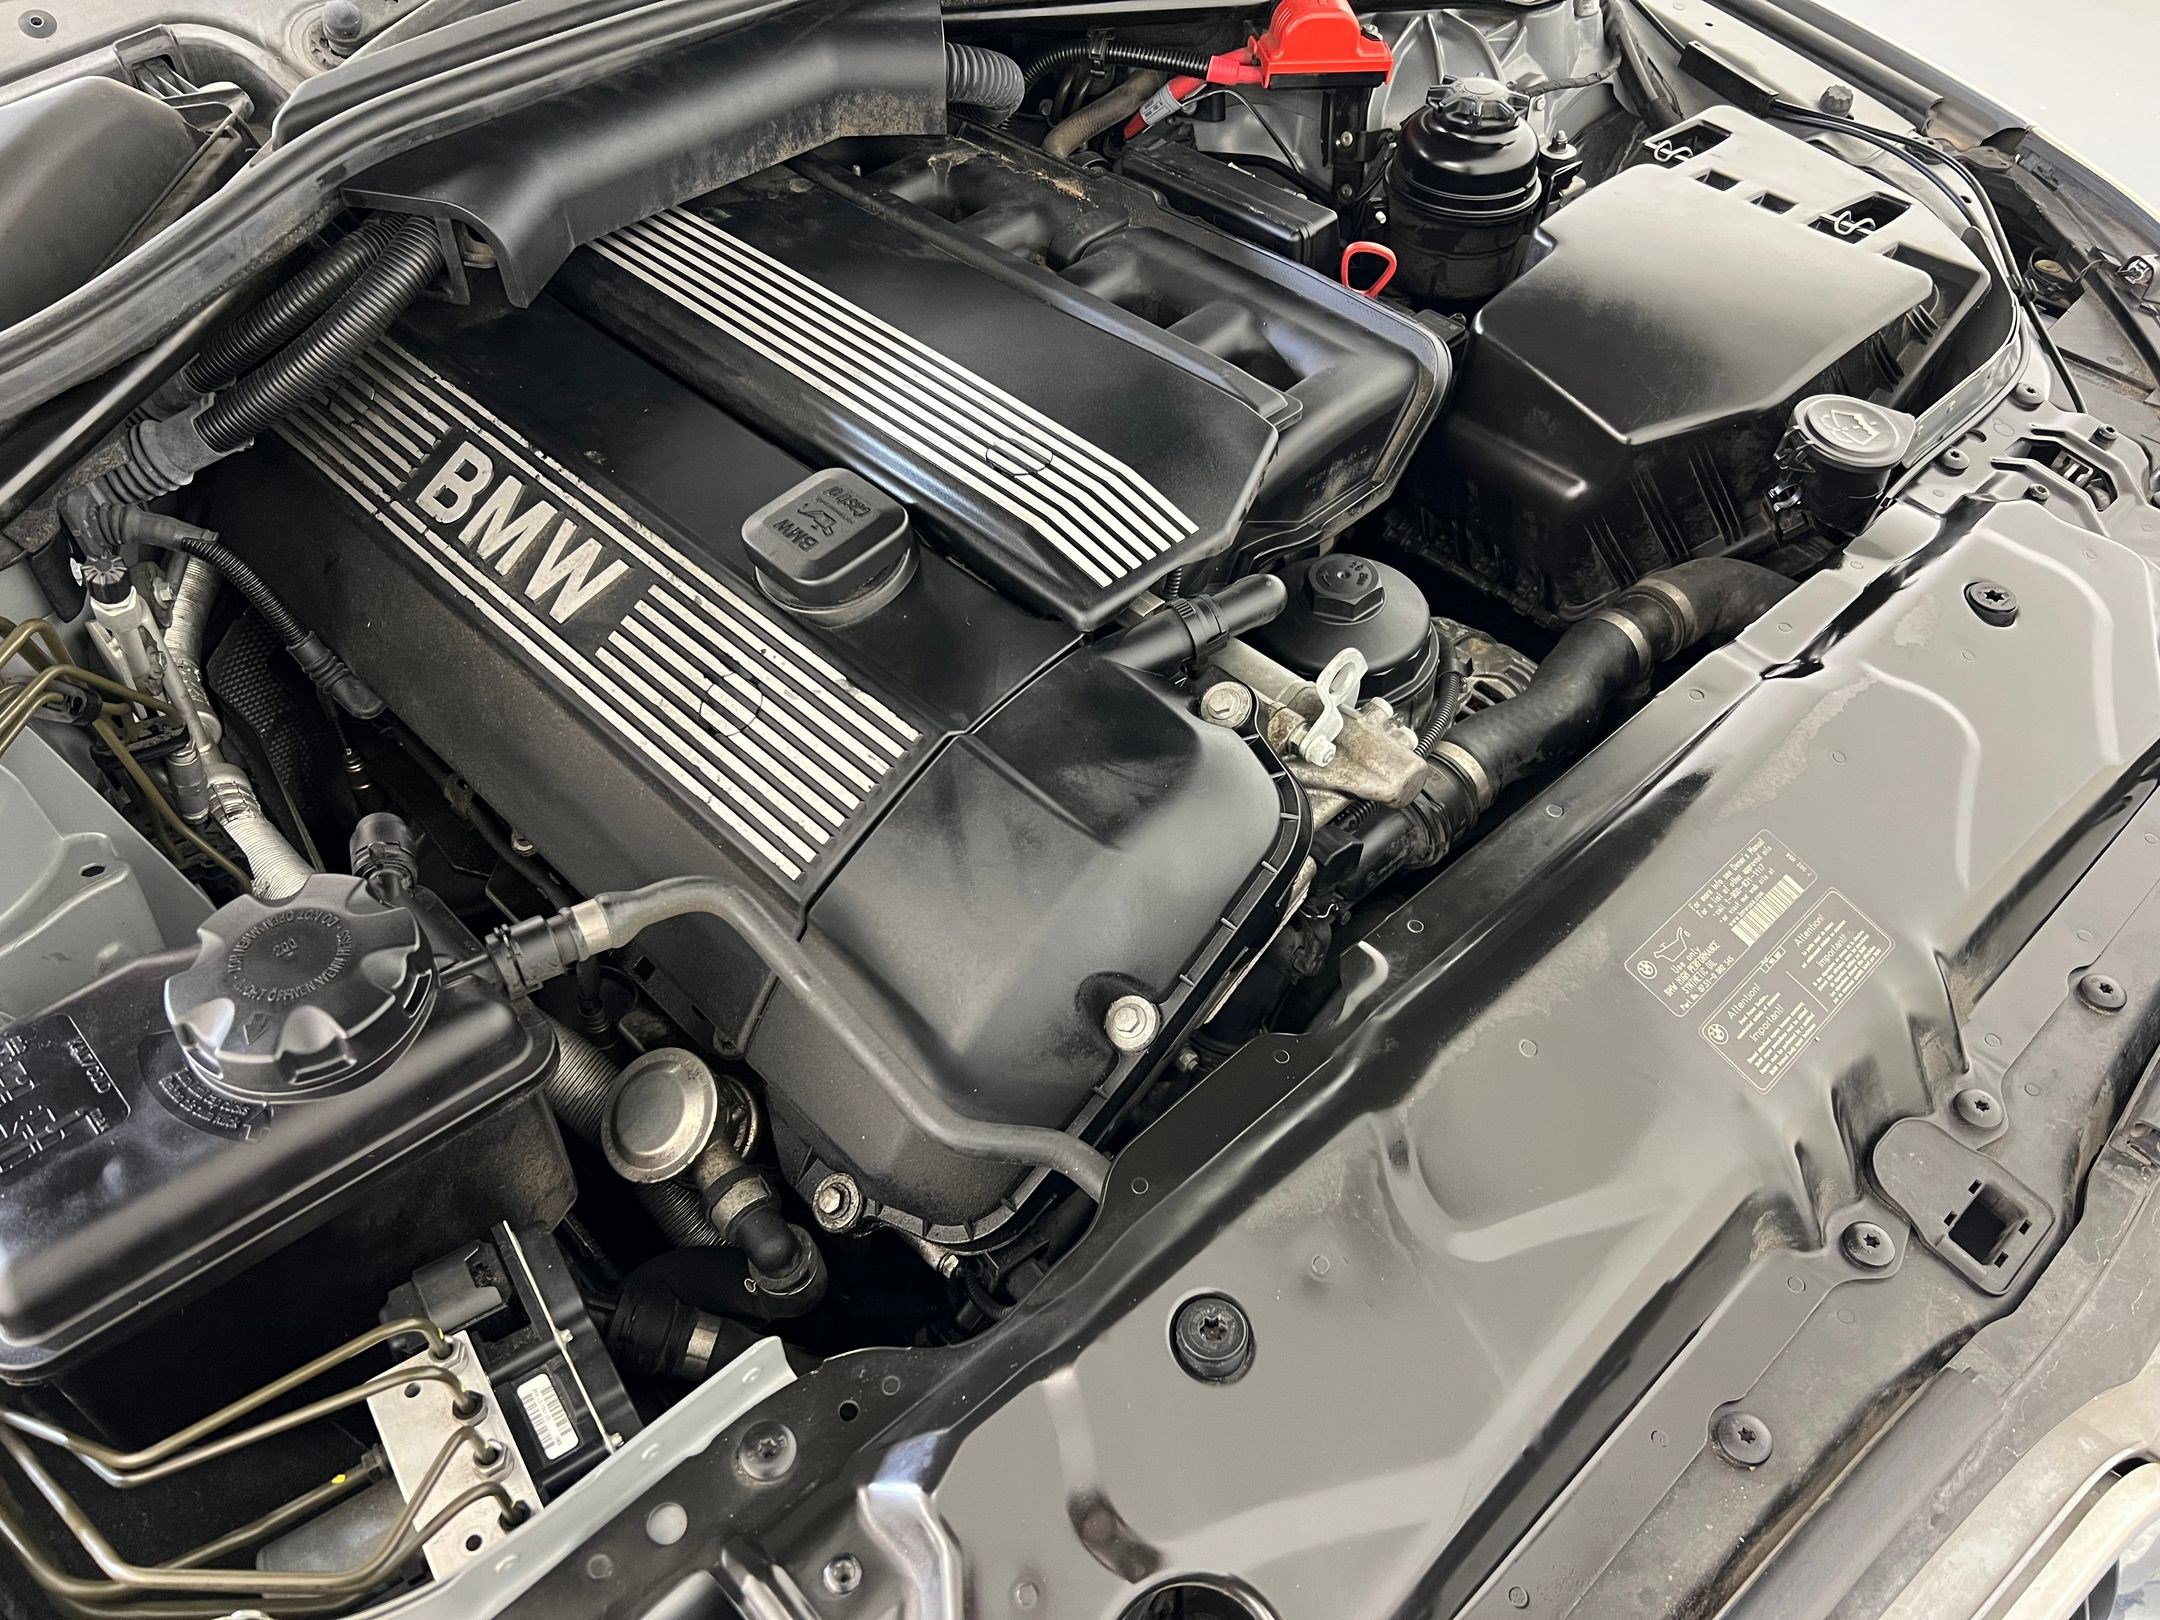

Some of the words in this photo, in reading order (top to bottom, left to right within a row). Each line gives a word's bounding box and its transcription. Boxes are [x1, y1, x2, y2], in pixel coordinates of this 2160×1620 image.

[415, 440, 630, 625] BMW
[772, 518, 819, 552] BMW
[262, 910, 294, 930] OPEN
[1687, 901, 1701, 912] For
[1695, 907, 1709, 919] For
[1794, 913, 1825, 948] Attention!
[1670, 961, 1686, 974] Use
[1685, 945, 1702, 962] only
[1815, 933, 1848, 968] Important!
[1663, 981, 1679, 998] BMW
[1674, 969, 1691, 986] HIGH
[1686, 939, 1721, 974] PERFORMANCE
[1681, 966, 1709, 995] SYNTHETIC
[1704, 959, 1718, 970] OIL
[1727, 982, 1761, 1020] Attention!
[1748, 1003, 1784, 1042] Important!
